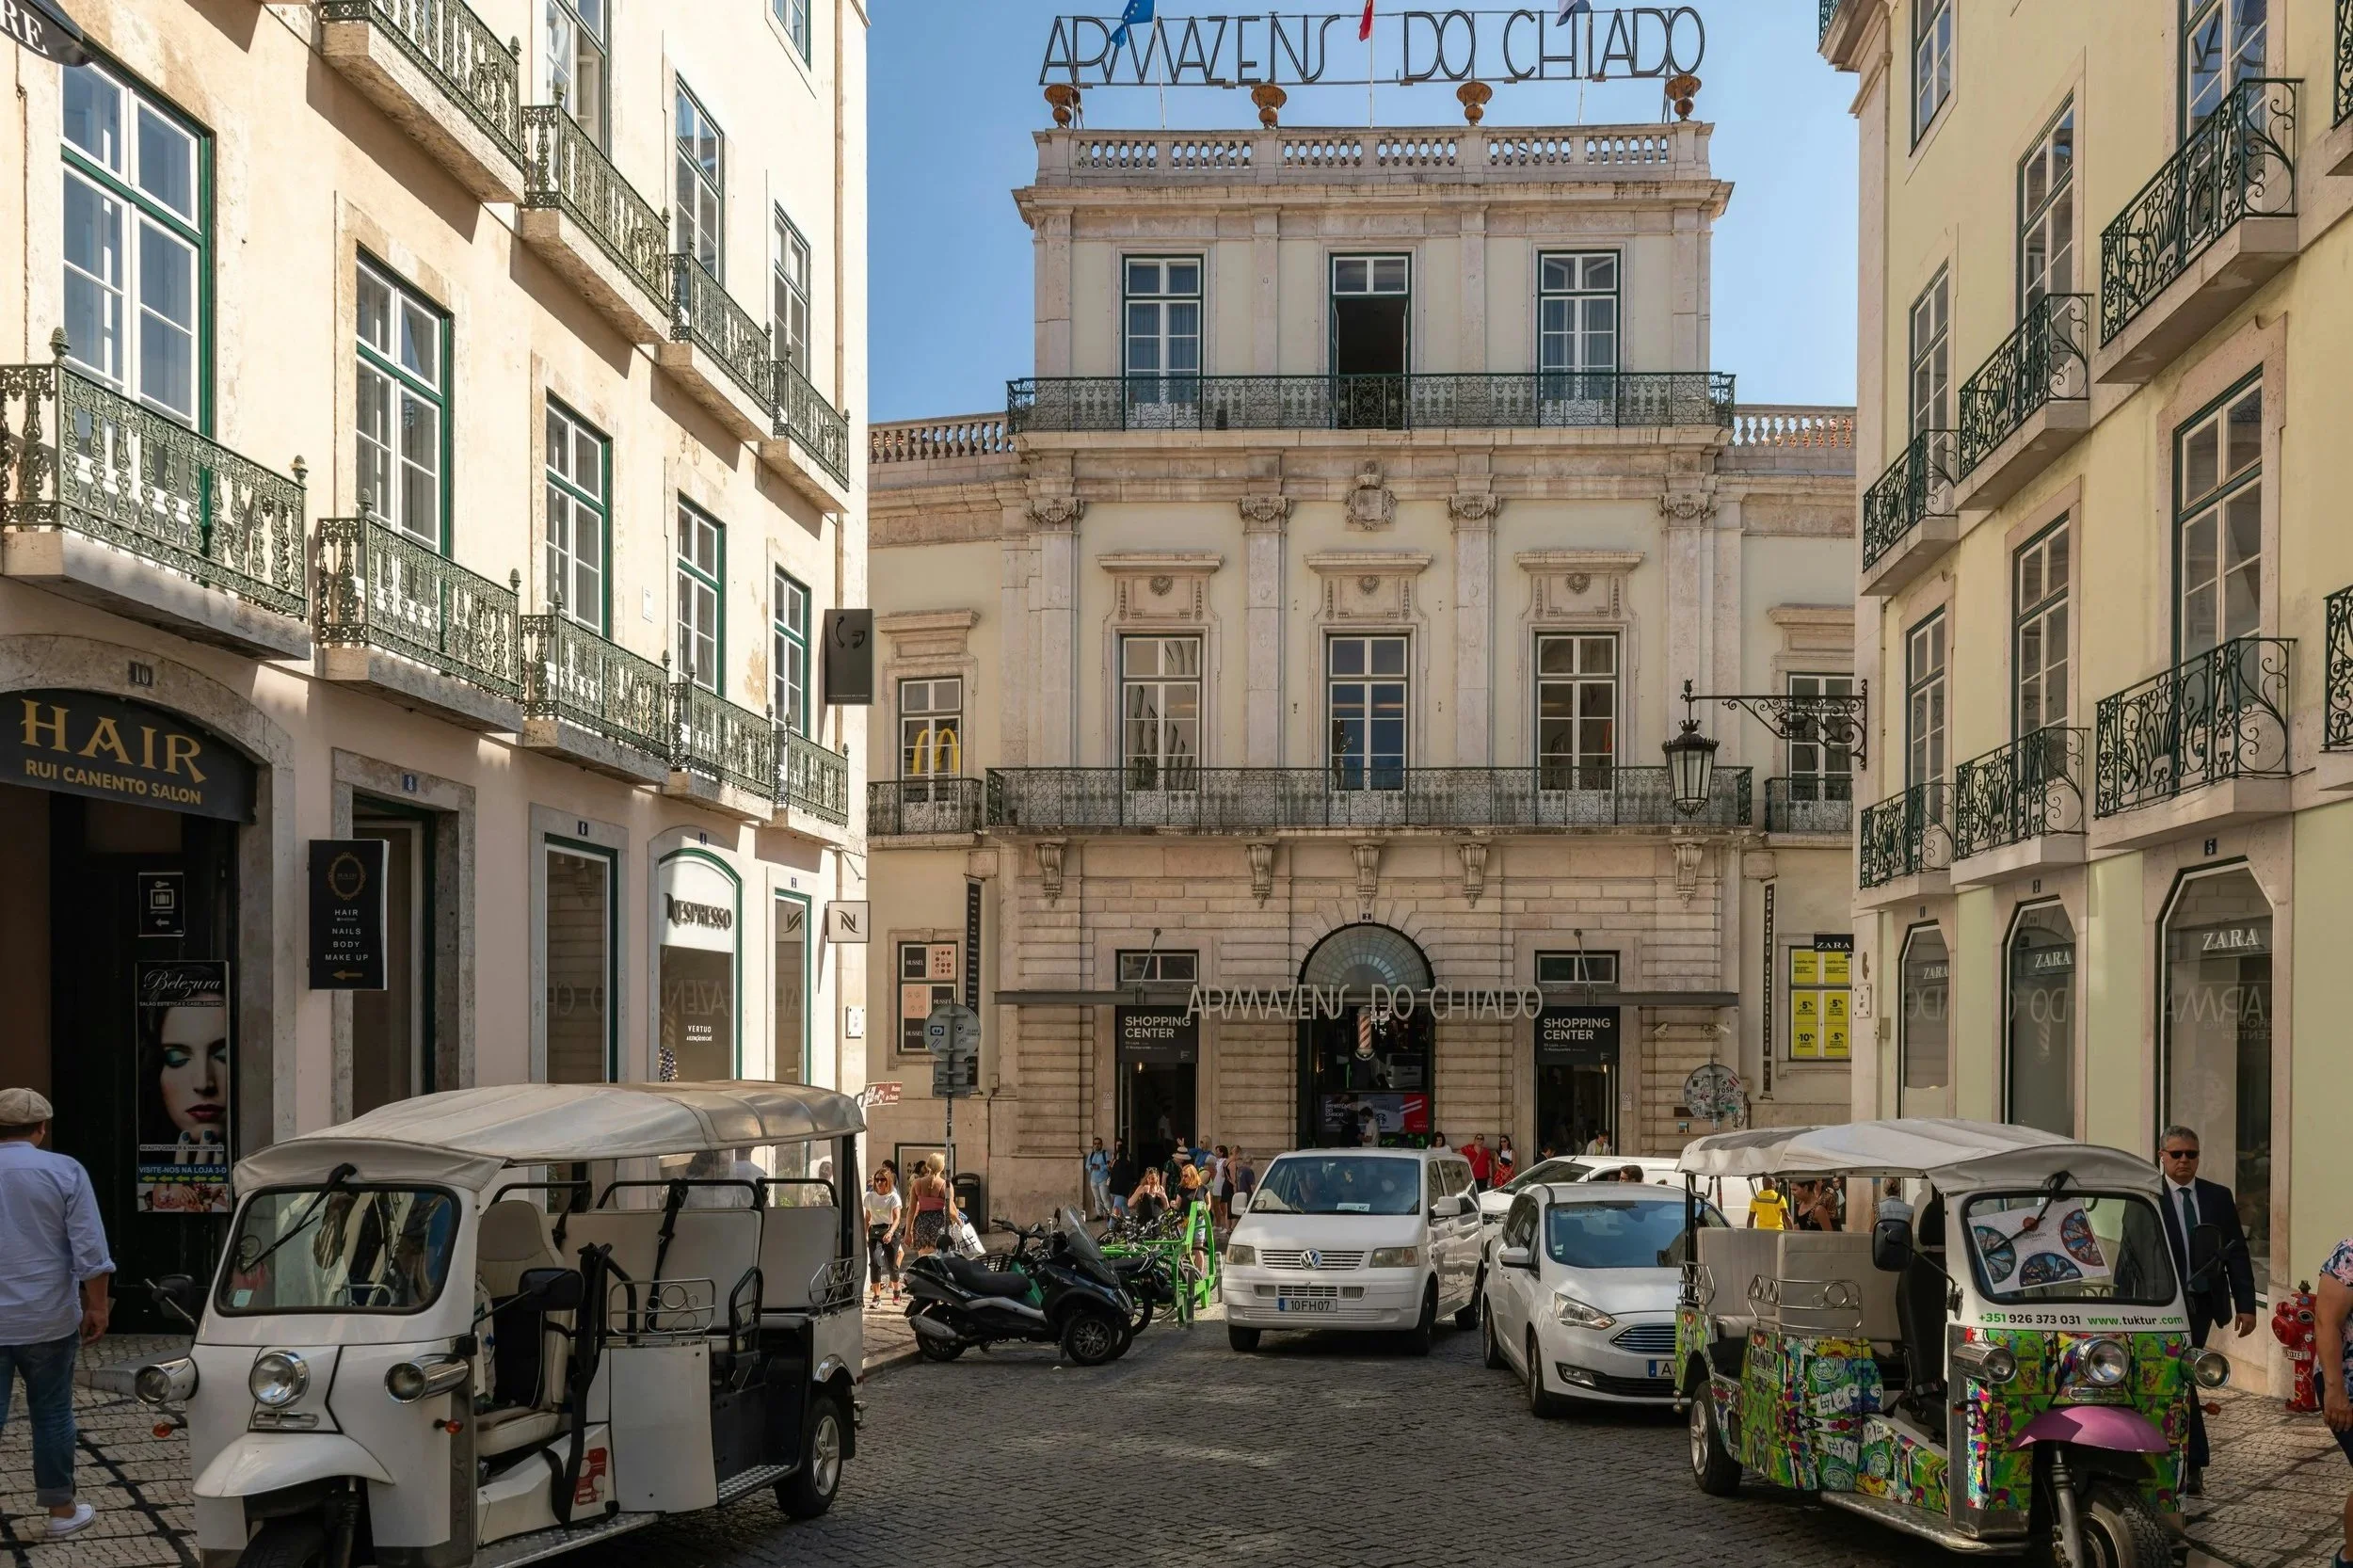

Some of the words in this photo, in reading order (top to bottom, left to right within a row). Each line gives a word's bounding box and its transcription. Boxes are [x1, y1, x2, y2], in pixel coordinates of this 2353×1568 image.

[1039, 14, 1340, 84] ARMAZENS
[1403, 9, 1476, 79] DO
[1503, 7, 1705, 79] CHIADO
[134, 664, 150, 685] 10
[20, 698, 207, 784] HAIR
[25, 759, 57, 780] RUI
[62, 766, 148, 795] CANENTO
[151, 782, 201, 805] SALON
[664, 893, 732, 930] NESPRESSO
[2202, 928, 2259, 951] ZARA
[2035, 951, 2073, 968] ZARA
[1923, 966, 1948, 980] ZARA
[143, 969, 221, 998] Belezura
[1186, 984, 1350, 1020] ARMAZENS
[1371, 984, 1415, 1020] DO
[1430, 984, 1544, 1020] CHIADO
[687, 1025, 712, 1033] VERTUO
[1125, 1016, 1192, 1027] SHOPPING
[1544, 1017, 1611, 1029] SHOPPING
[1125, 1028, 1175, 1038] CENTER
[1544, 1030, 1594, 1040] CENTER
[1290, 1300, 1330, 1311] 10FH07
[1978, 1313, 2007, 1322] +351
[2009, 1314, 2032, 1324] 926
[2036, 1314, 2057, 1324] 373
[2060, 1315, 2081, 1324] 031
